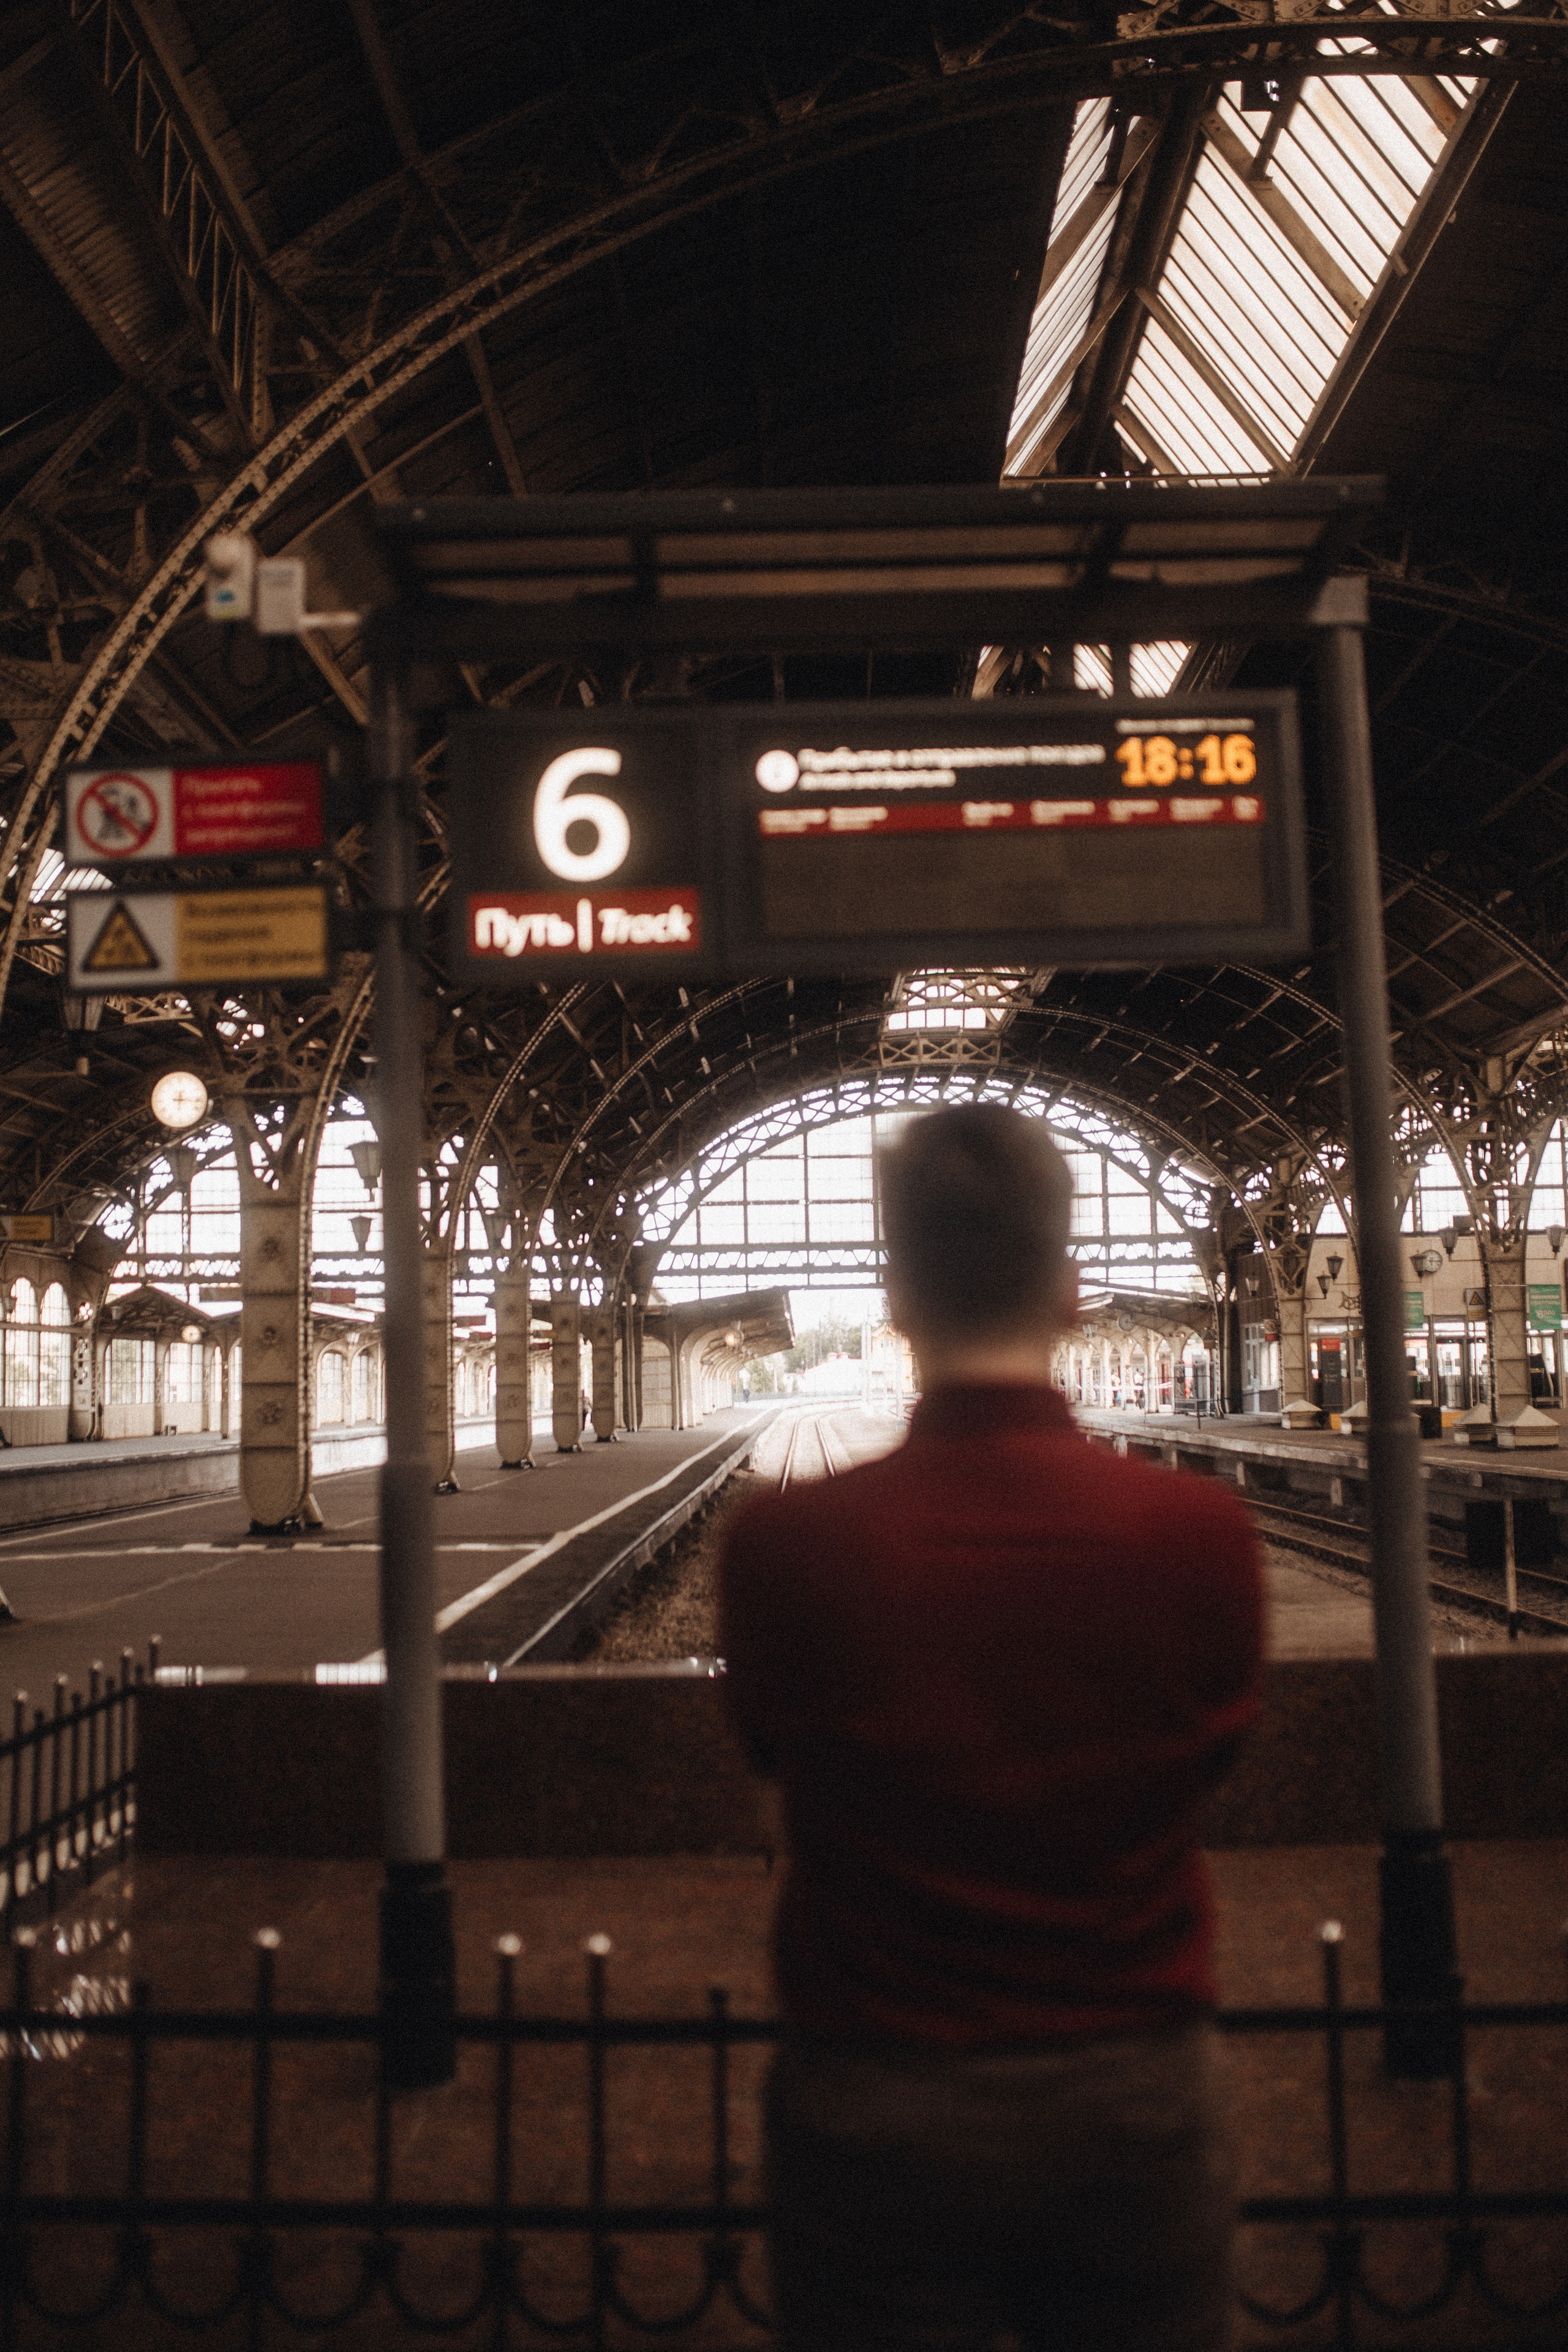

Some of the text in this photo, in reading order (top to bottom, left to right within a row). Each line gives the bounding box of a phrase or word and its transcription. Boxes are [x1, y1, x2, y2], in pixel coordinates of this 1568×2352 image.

[1116, 734, 1257, 786] 18:16
[533, 747, 631, 882] 6
[475, 907, 575, 957] Путь
[598, 903, 692, 944] Track
